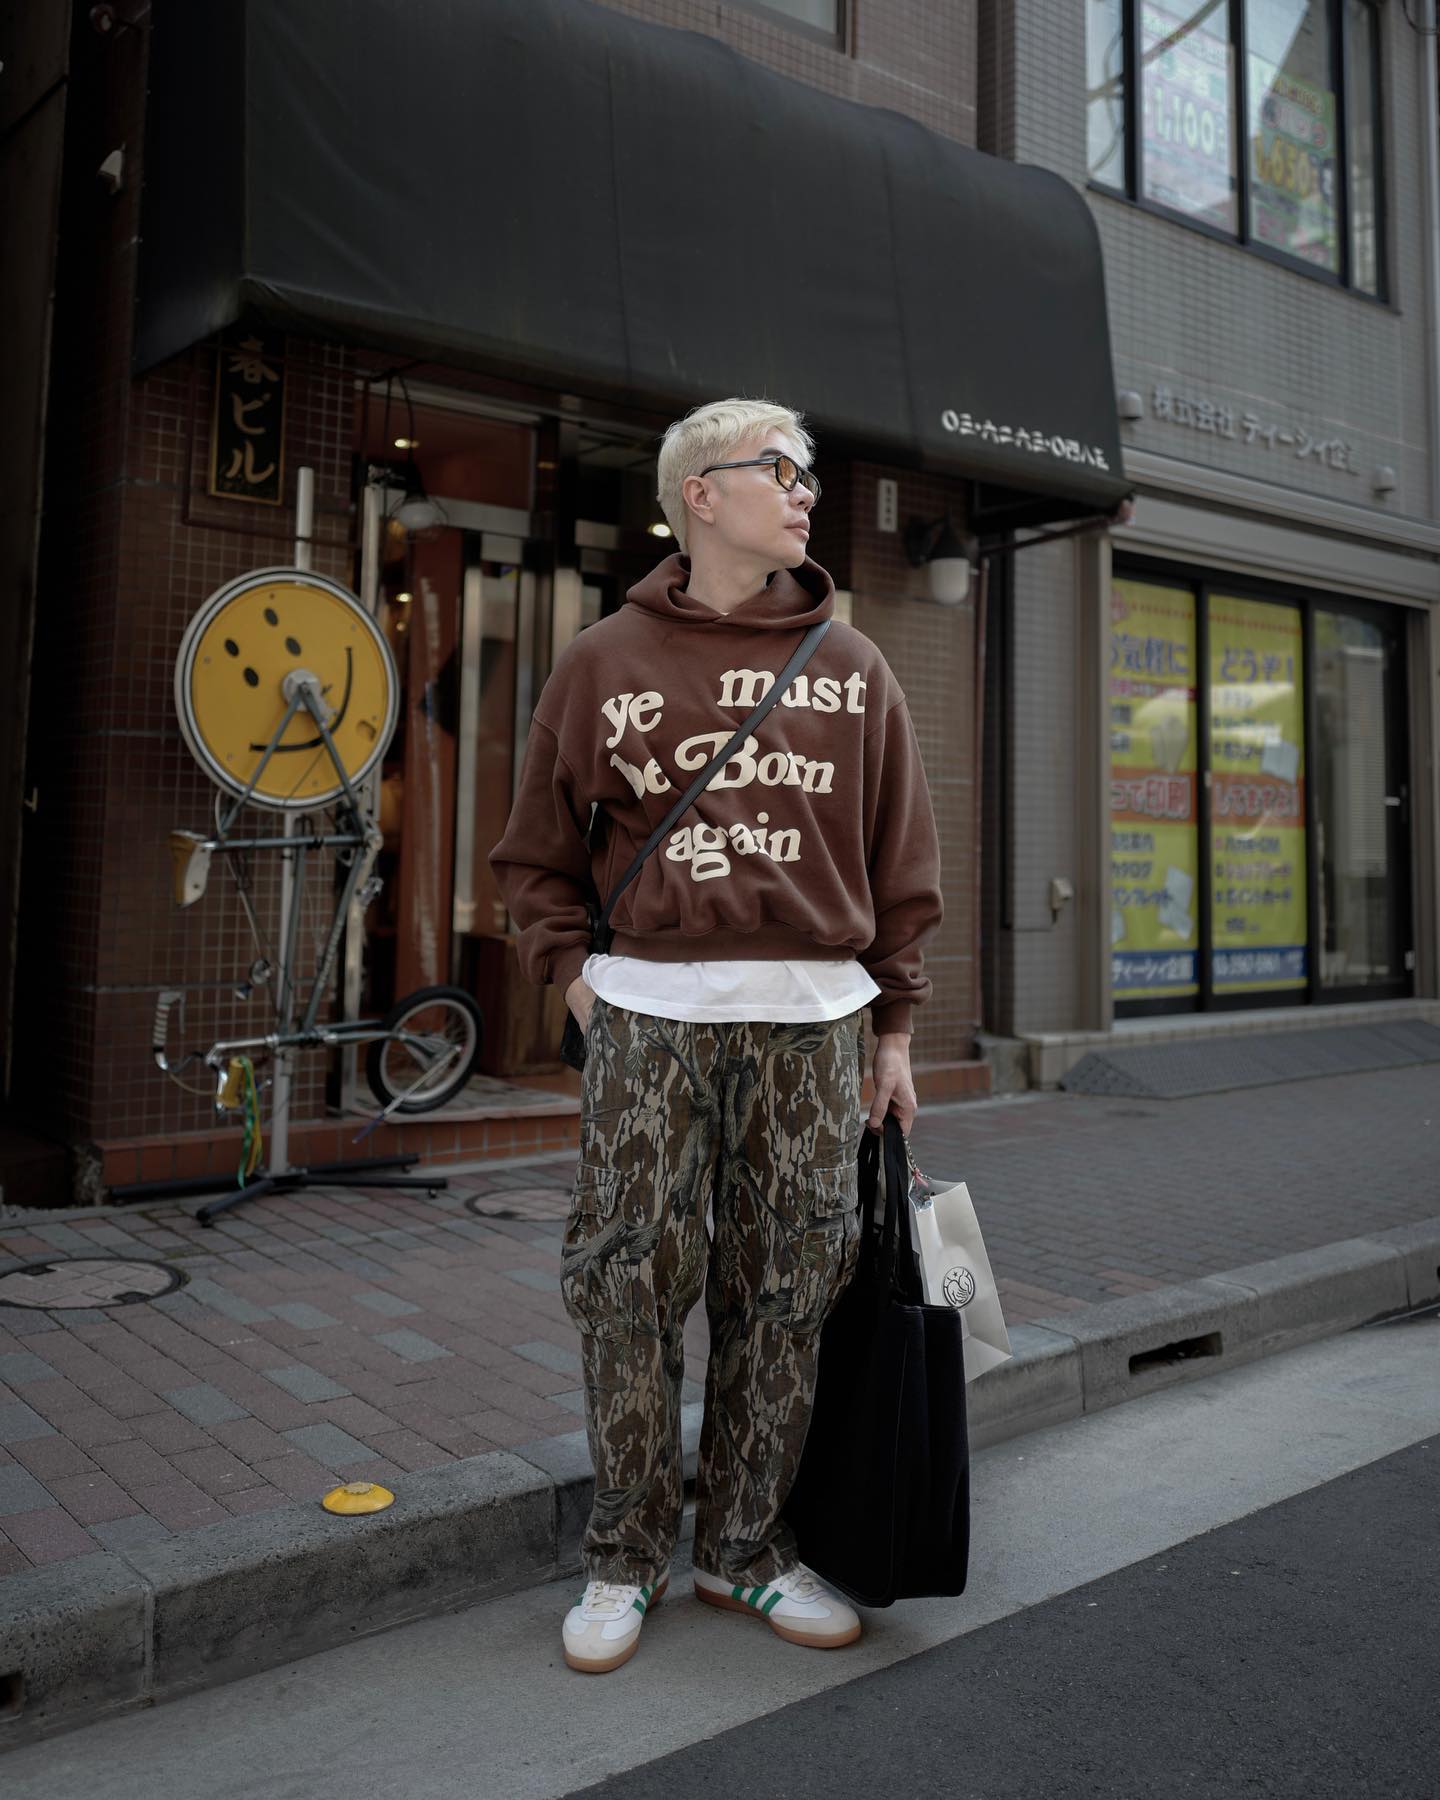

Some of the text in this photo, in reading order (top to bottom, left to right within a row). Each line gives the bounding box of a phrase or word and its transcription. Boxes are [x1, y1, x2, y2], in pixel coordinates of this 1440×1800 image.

[1153, 383, 1236, 440] 株式会社
[601, 668, 867, 748] ye must
[674, 731, 835, 795] Born
[665, 811, 801, 882] again
